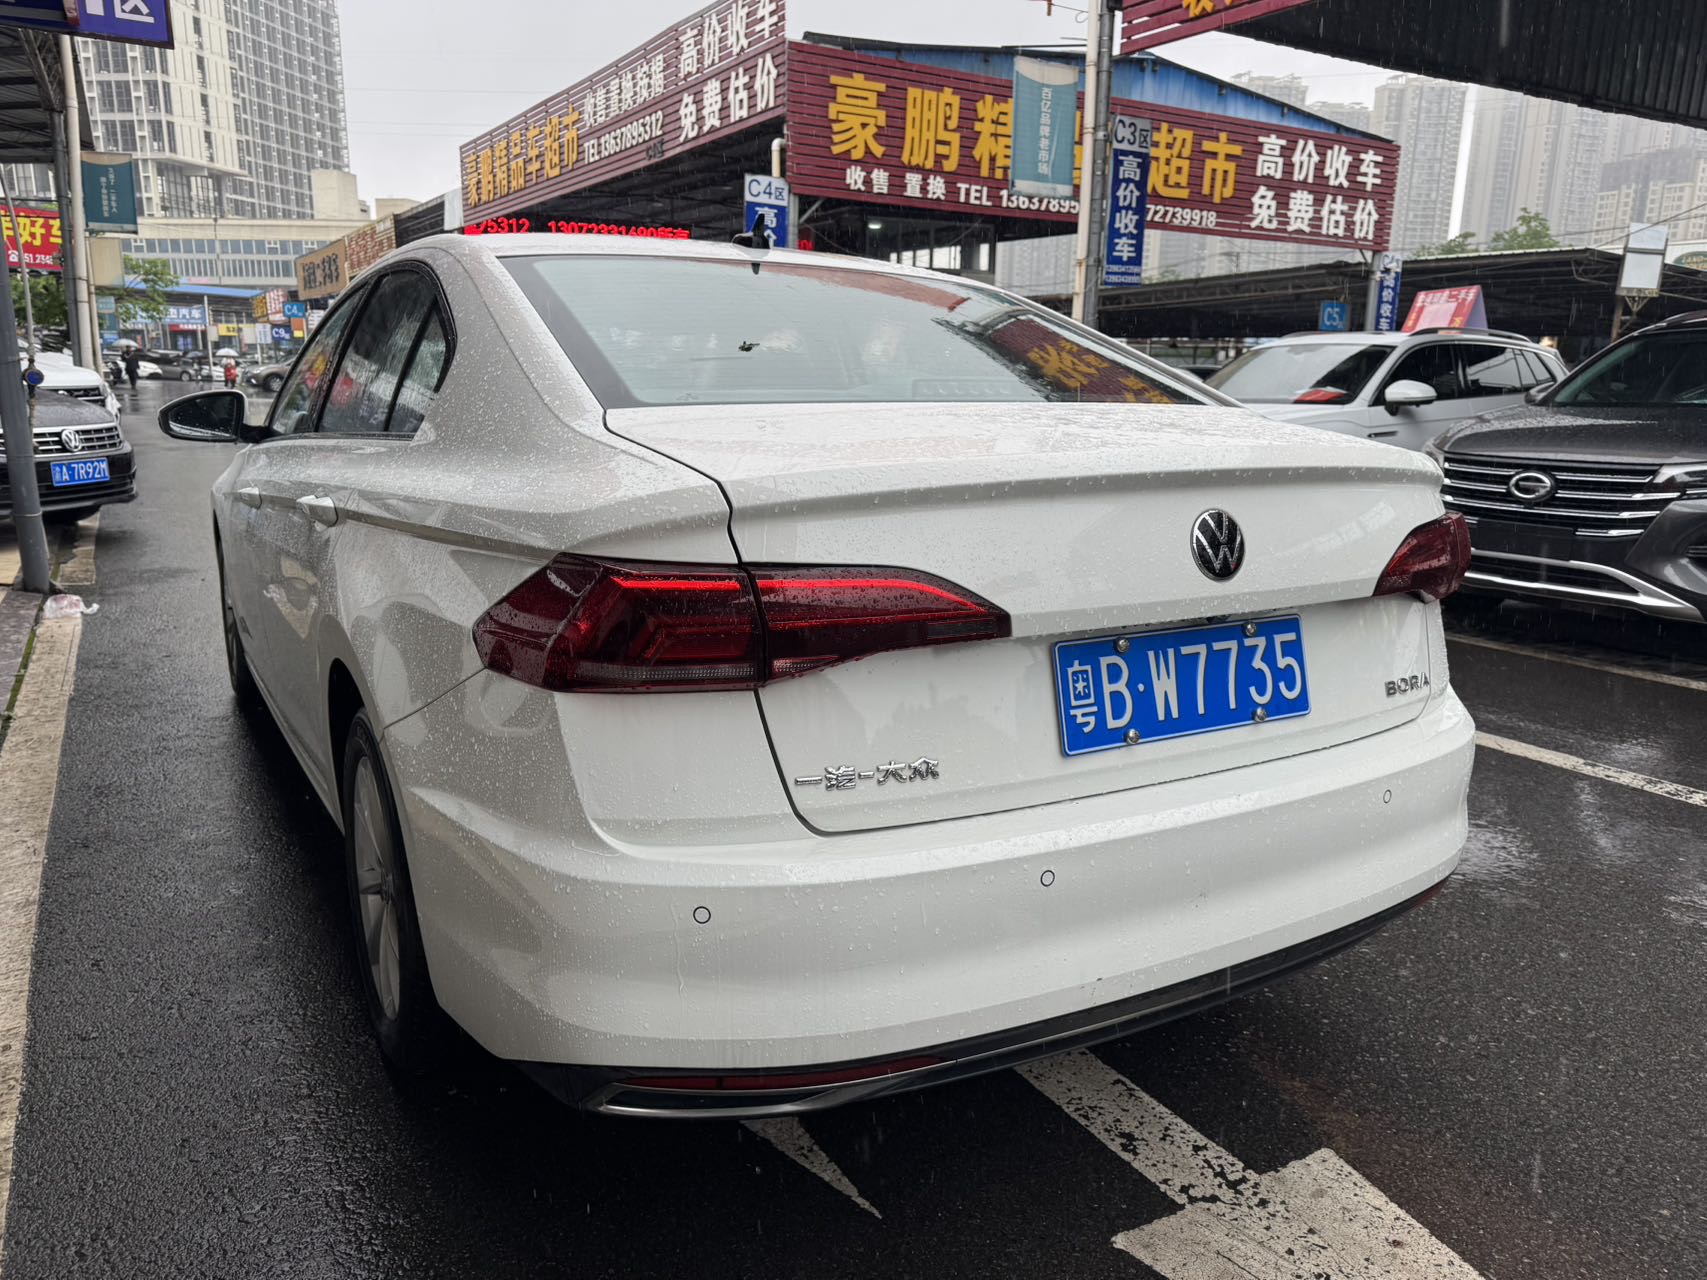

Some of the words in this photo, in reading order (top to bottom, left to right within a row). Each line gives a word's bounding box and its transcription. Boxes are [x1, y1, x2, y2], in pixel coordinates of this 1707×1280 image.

[678, 0, 778, 78] 高价收车
[679, 53, 778, 142] 免费估价
[466, 103, 580, 207] 豪鹏精品车超市
[1114, 119, 1150, 149] C3区
[748, 178, 785, 200] C4区
[1255, 134, 1384, 192] 高价收车
[956, 182, 993, 207] TEL
[1112, 155, 1142, 262] 高价收车
[1250, 185, 1380, 241] 免费估价
[1384, 672, 1429, 698] BORA
